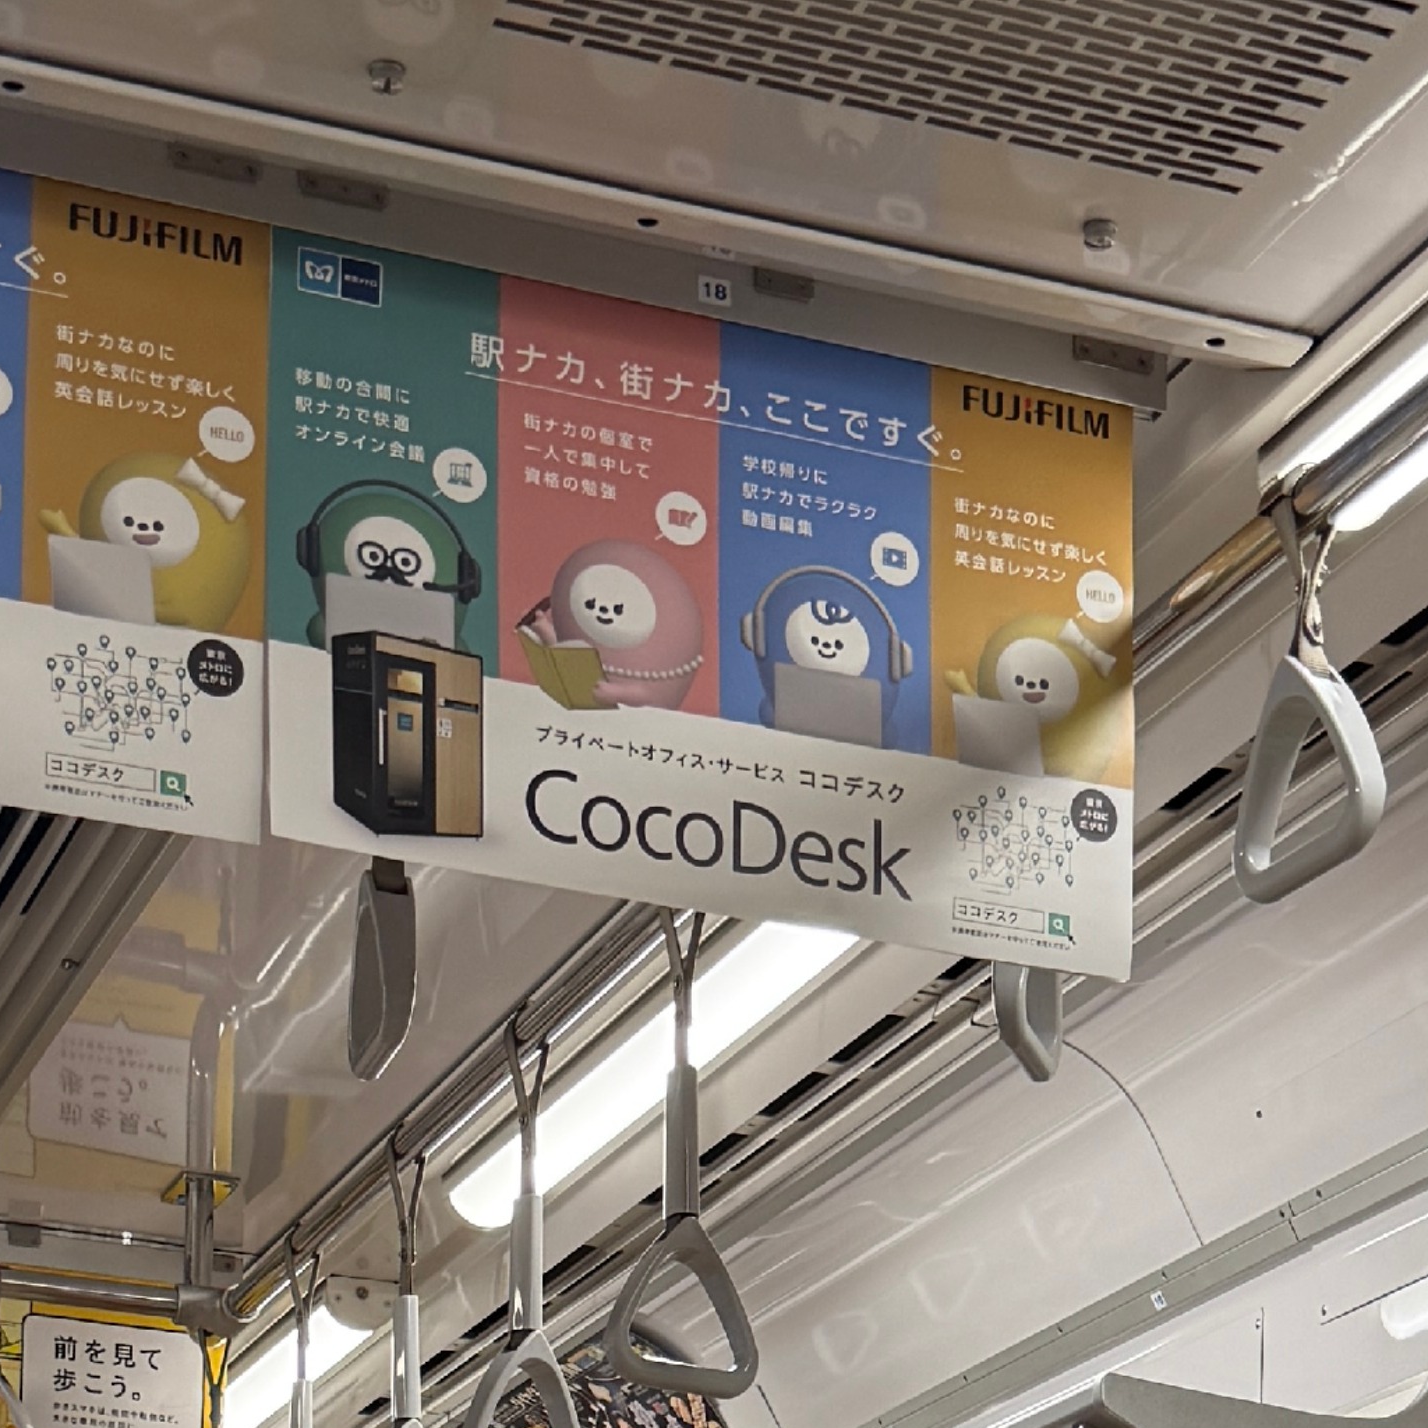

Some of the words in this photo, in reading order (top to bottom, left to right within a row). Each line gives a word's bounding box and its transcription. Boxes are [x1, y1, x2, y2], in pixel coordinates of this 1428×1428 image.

[69, 202, 244, 266] FUJIFILM
[702, 282, 728, 301] 18
[56, 323, 176, 363] 街ナカなのに
[55, 352, 237, 403] 周りを気にせず楽しく
[295, 366, 410, 405] 移動の合間に
[53, 380, 188, 420] 英会話レッスン
[294, 395, 410, 433] 駅ナカで快適
[470, 332, 962, 462] 駅ナカ、街ナカ、ここですぐ。
[963, 385, 1110, 440] FUJIFILM
[209, 425, 245, 444] HELLO
[294, 423, 426, 464] オンライン会議
[523, 412, 653, 453] 街ナカの個室で
[523, 444, 651, 480] 一人で集中して
[742, 453, 829, 487] 学校帰りに
[523, 466, 617, 502] 資格の勉強
[741, 480, 879, 522] 駅ナカでラクラク
[741, 509, 814, 538] 動画編集
[954, 497, 1056, 531] 街ナカなのに
[953, 523, 1108, 568] 周りを気にせず楽しく
[953, 550, 1068, 584] 英会話レッスン
[1085, 587, 1116, 605] HELLO
[50, 758, 125, 783] ココデスク
[535, 725, 786, 785] プライベートオフィス・サービス
[798, 769, 906, 804] ココデスク
[524, 768, 913, 902] CocoDesk
[956, 904, 1019, 925] ココデスク
[52, 1334, 163, 1371] 前を見て
[52, 1368, 142, 1402] 歩こう。
